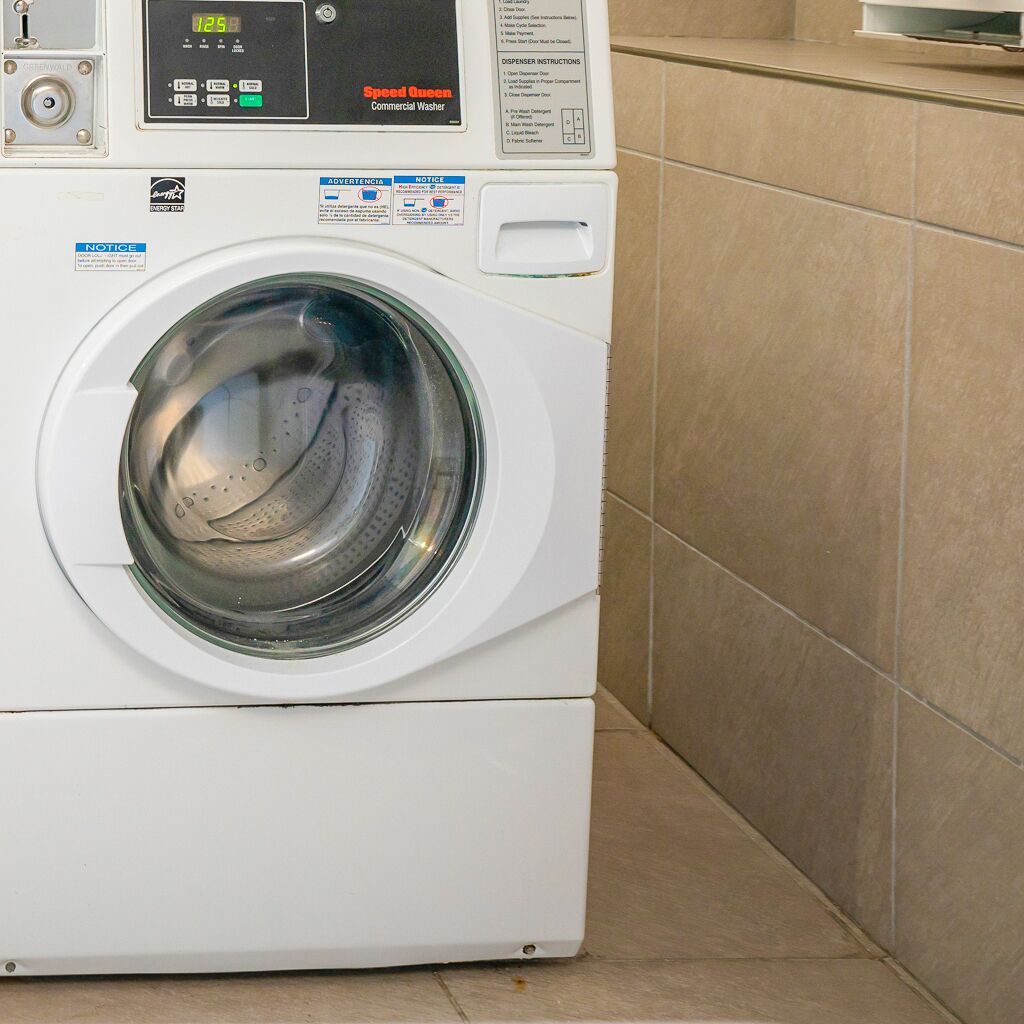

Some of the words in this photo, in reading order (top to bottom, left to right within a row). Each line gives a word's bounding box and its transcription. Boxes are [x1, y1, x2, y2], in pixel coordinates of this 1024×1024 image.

[197, 16, 227, 33] 125
[22, 63, 73, 72] GREENWALD
[363, 86, 407, 100] Speed
[408, 86, 452, 98] Queen
[371, 101, 416, 111] Commercial
[416, 102, 446, 111] Washer
